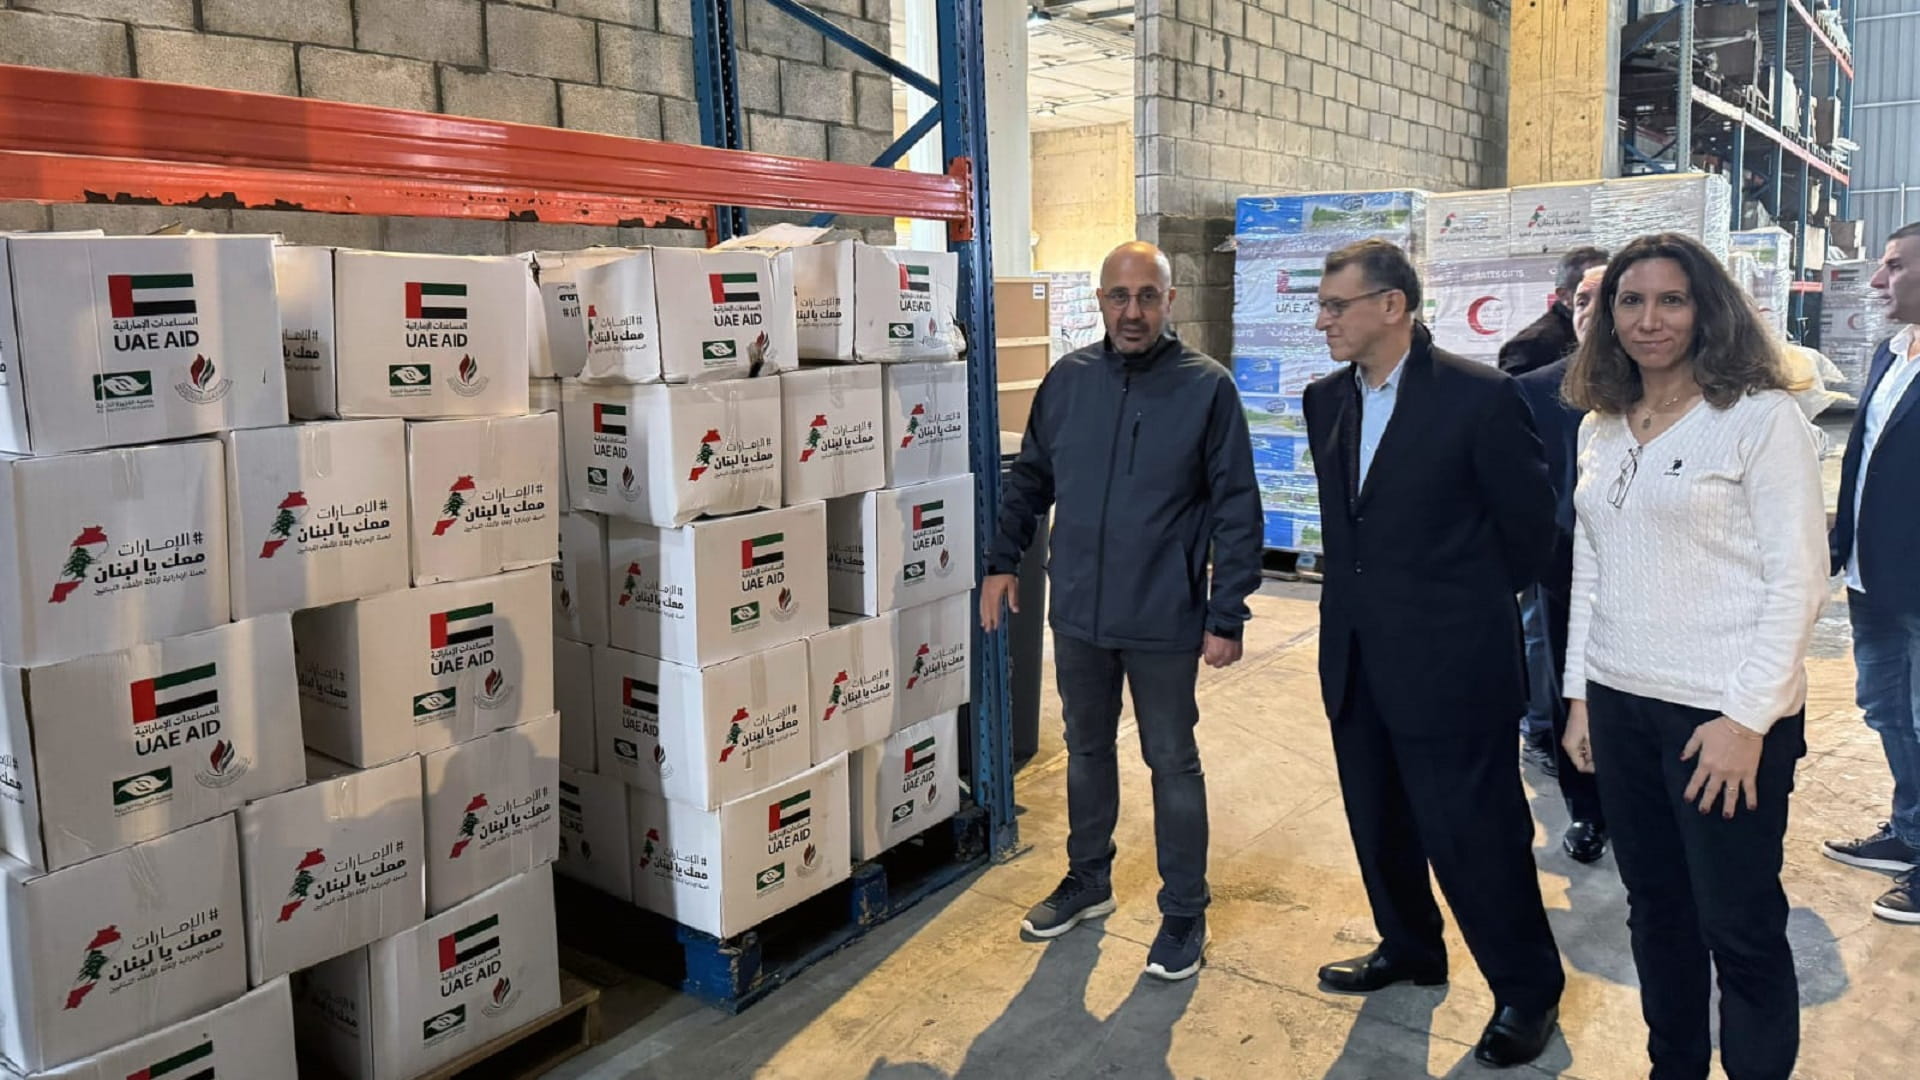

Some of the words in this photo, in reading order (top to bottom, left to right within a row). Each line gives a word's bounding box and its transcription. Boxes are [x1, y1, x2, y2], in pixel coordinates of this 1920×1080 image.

[714, 314, 738, 326] UAE
[742, 314, 762, 326] AID
[114, 331, 160, 352] UAE
[164, 330, 200, 349] AID
[406, 334, 438, 348] UAE
[442, 334, 468, 348] AID
[594, 332, 610, 344] لبنان
[611, 331, 620, 344] يا
[620, 330, 644, 342] معك
[821, 437, 842, 452] لبنان
[844, 436, 851, 449] يا
[852, 434, 874, 445] معك
[594, 443, 611, 458] UAE
[612, 446, 628, 459] AID
[750, 452, 773, 463] معك
[714, 454, 738, 470] لبنان
[740, 453, 749, 468] يا
[465, 504, 498, 522] لبنان
[500, 504, 510, 518] يا
[513, 500, 544, 512] معك
[297, 522, 334, 543] لبنان
[338, 521, 350, 538] يا
[353, 518, 390, 532] معك
[913, 538, 930, 551] UAE
[931, 534, 944, 547] AID
[144, 558, 157, 576] يا
[162, 552, 206, 568] معك
[94, 560, 138, 584] لبنان
[742, 578, 764, 592] UAE
[766, 572, 784, 586] AID
[430, 657, 465, 676] UAE
[466, 650, 494, 668] AID
[870, 682, 890, 694] معك
[622, 717, 641, 735] UAE
[642, 722, 658, 738] AID
[764, 726, 774, 739] يا
[776, 718, 798, 733] معك
[136, 729, 182, 756] UAE
[186, 719, 222, 744] AID
[740, 728, 764, 748] لبنان
[522, 804, 550, 820] معك
[480, 816, 508, 840] لبنان
[511, 814, 520, 828] يا
[768, 838, 791, 855] UAE
[792, 828, 811, 846] AID
[370, 859, 406, 878] معك
[684, 866, 709, 881] معك
[355, 870, 366, 886] يا
[314, 874, 350, 900] لبنان
[177, 929, 222, 951] معك
[158, 945, 173, 962] يا
[108, 949, 154, 982] لبنان
[440, 976, 474, 998] UAE
[476, 960, 502, 984] AID
